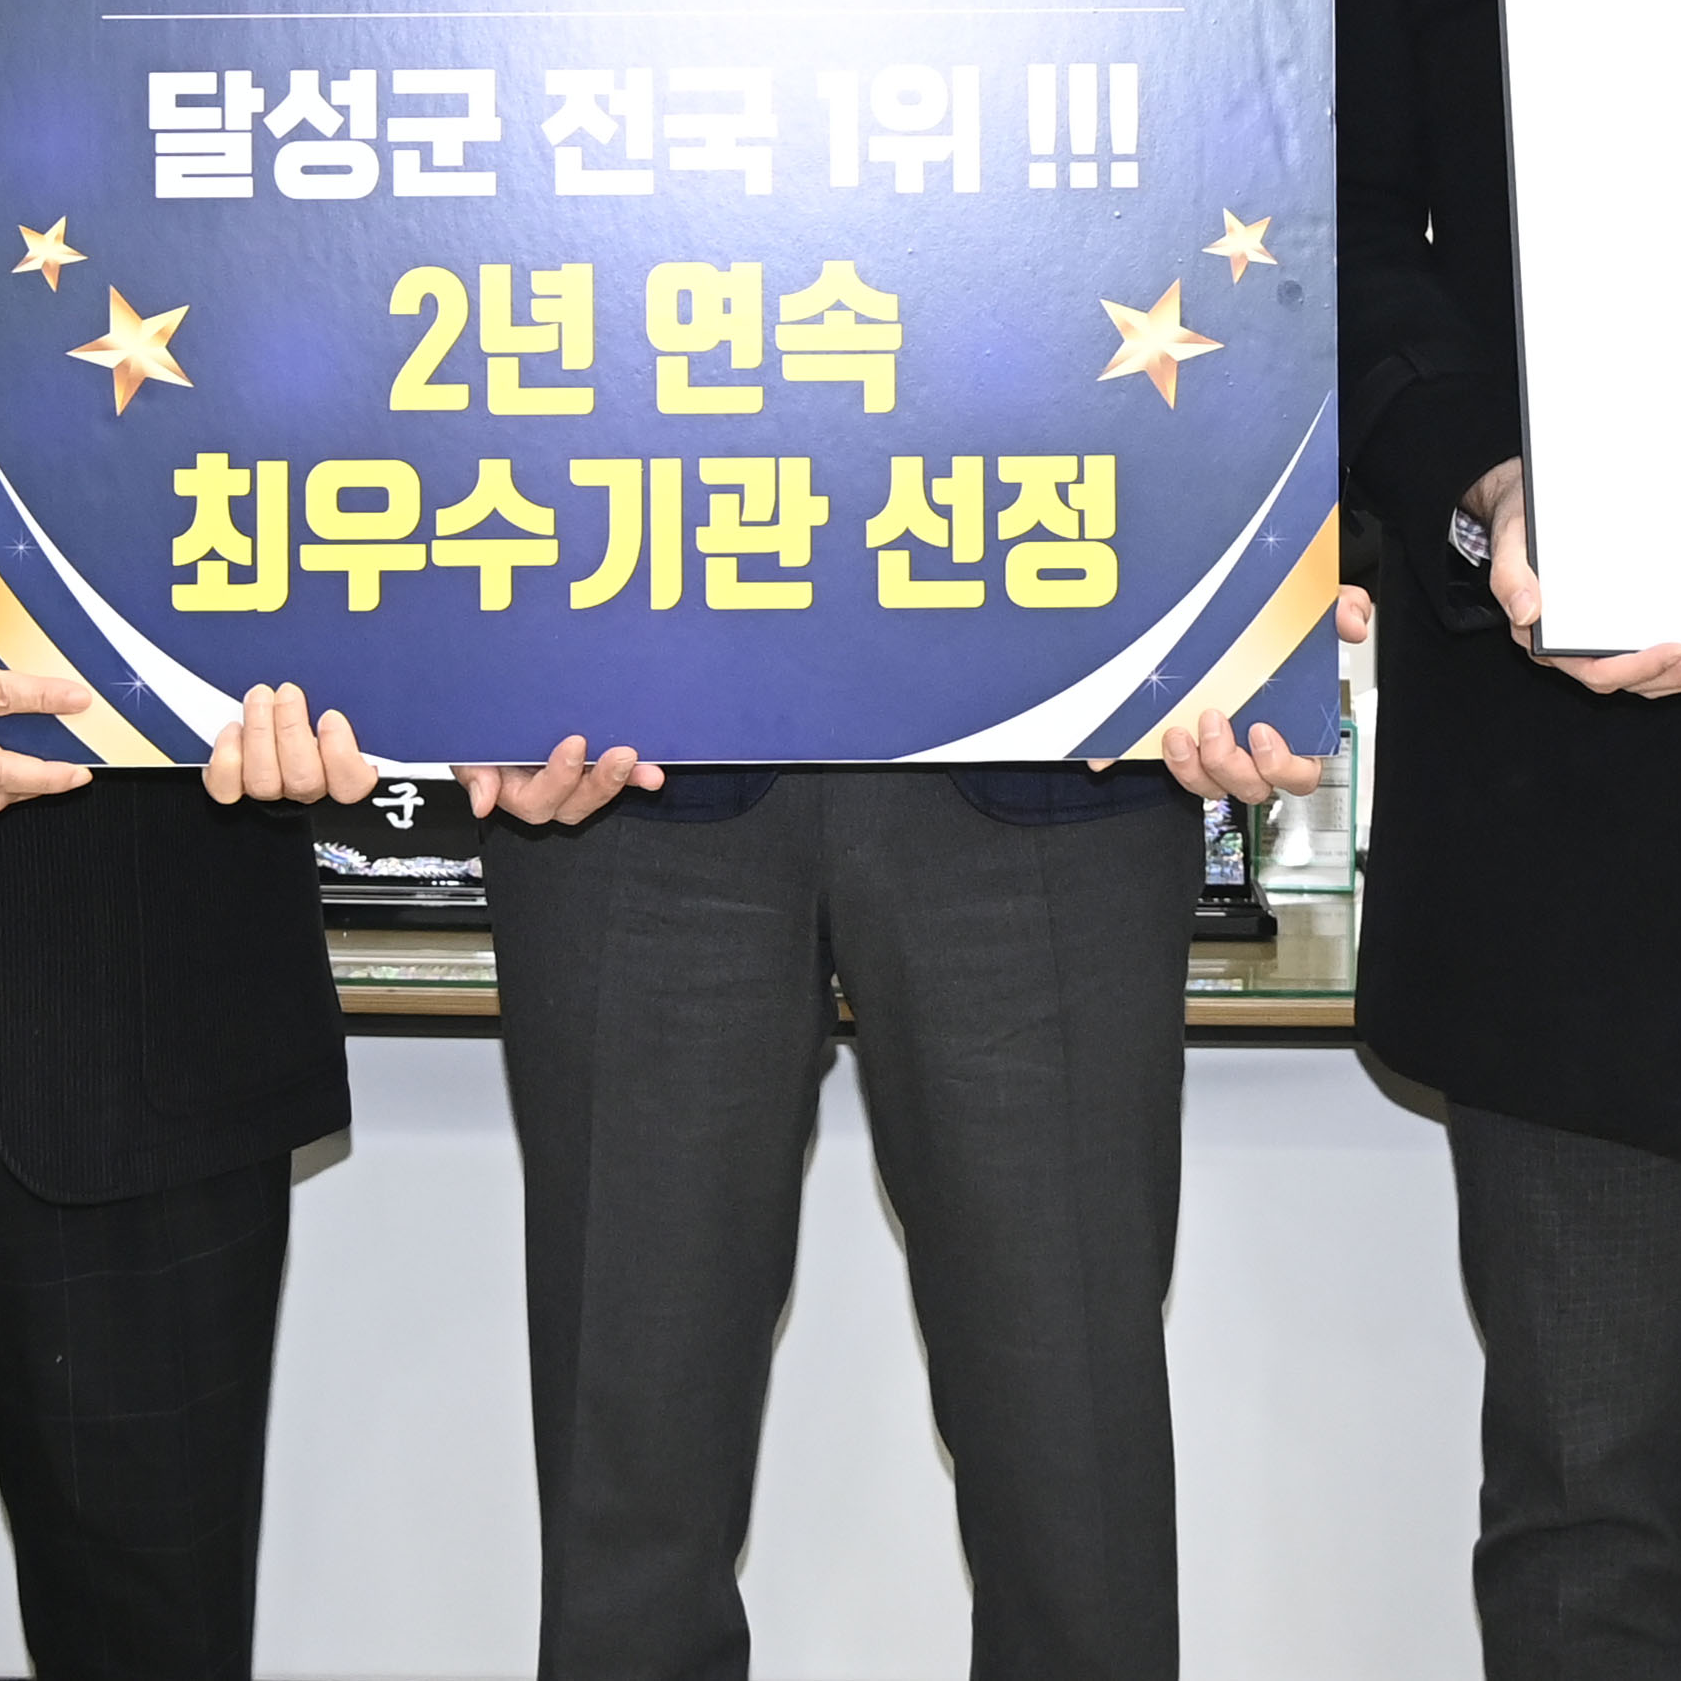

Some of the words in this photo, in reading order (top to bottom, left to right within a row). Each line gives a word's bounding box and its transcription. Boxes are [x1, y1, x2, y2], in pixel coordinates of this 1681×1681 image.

[147, 67, 503, 201] 달성군
[539, 65, 777, 198] 전국
[813, 62, 980, 196] 1위
[1028, 62, 1140, 190] !!!
[388, 261, 595, 417] 2년
[645, 258, 904, 415] 연속
[170, 451, 829, 614] 최우수기관
[864, 453, 1120, 611] 선정
[372, 782, 425, 830] 군
